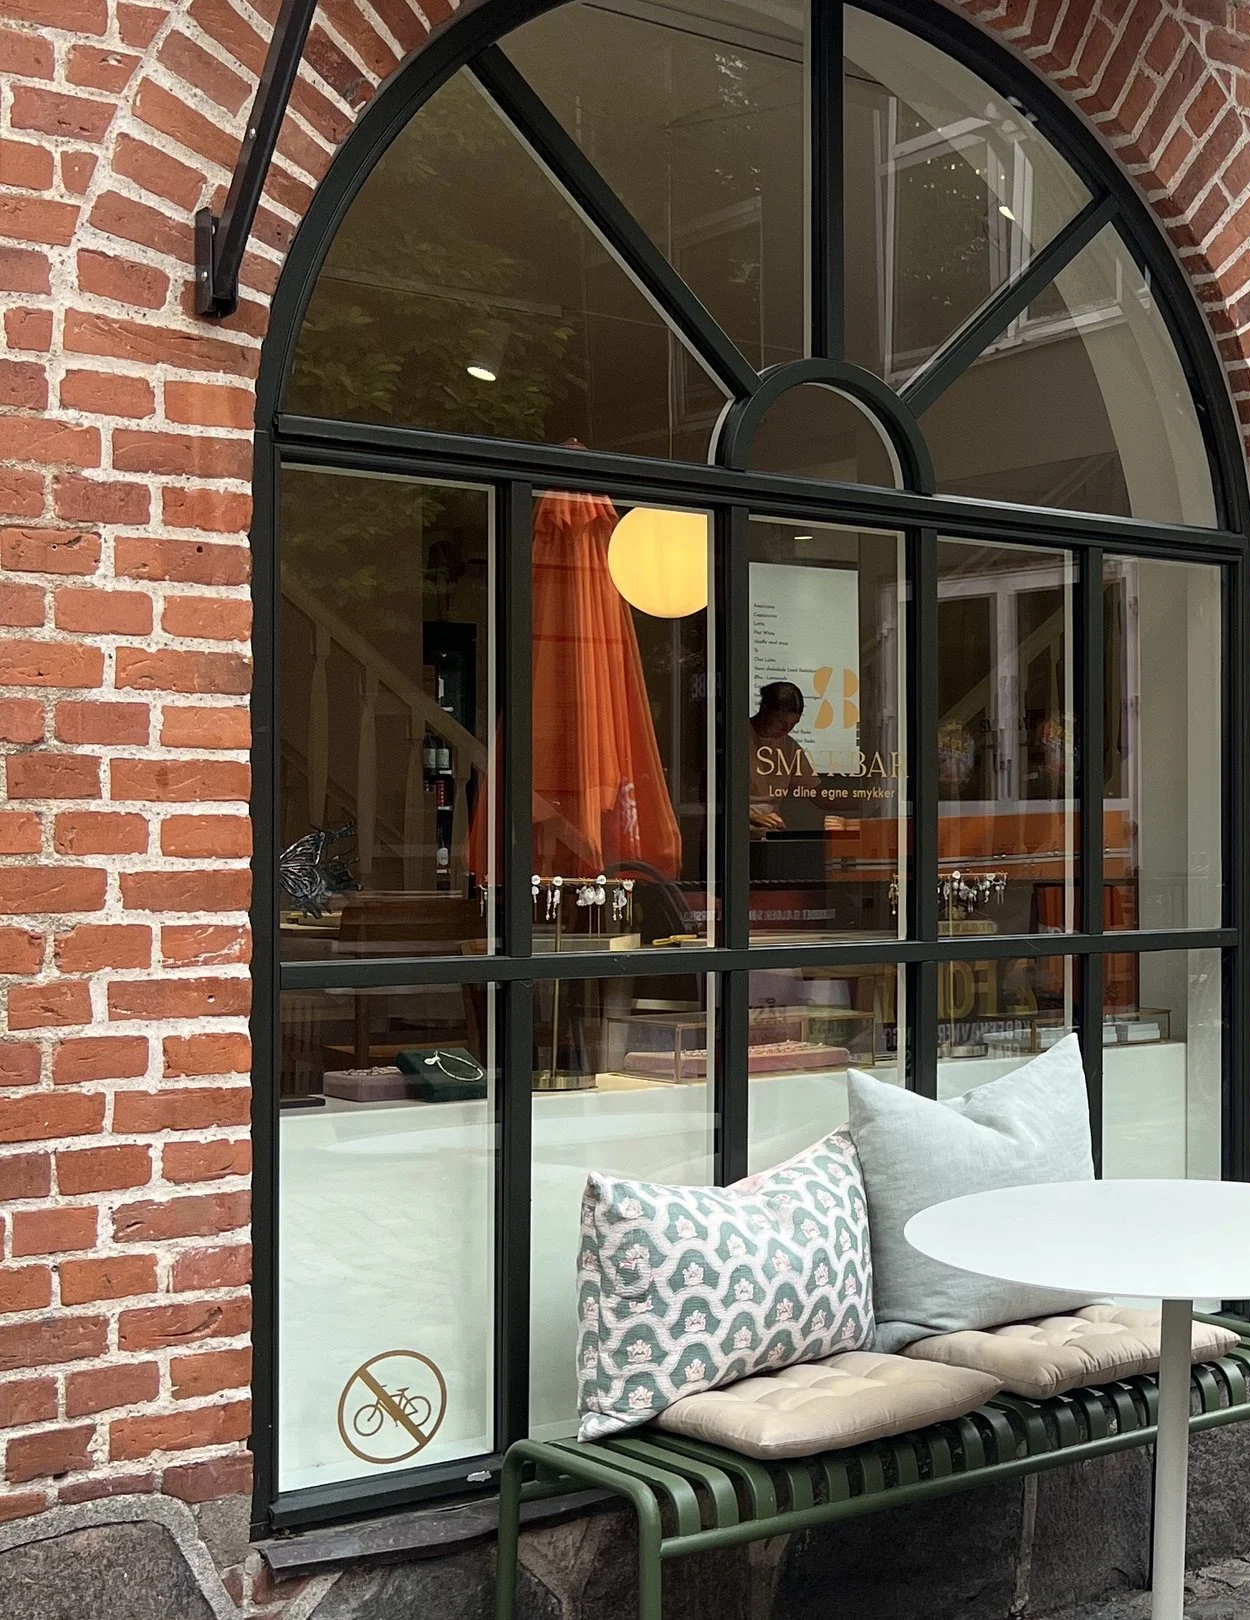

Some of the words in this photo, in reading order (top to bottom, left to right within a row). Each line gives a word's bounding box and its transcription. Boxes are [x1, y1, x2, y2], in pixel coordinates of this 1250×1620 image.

[756, 745, 909, 779] SMYKBAR
[769, 785, 788, 797] Lav
[793, 785, 817, 798] dine
[821, 788, 849, 801] egne
[852, 787, 896, 801] smykker
